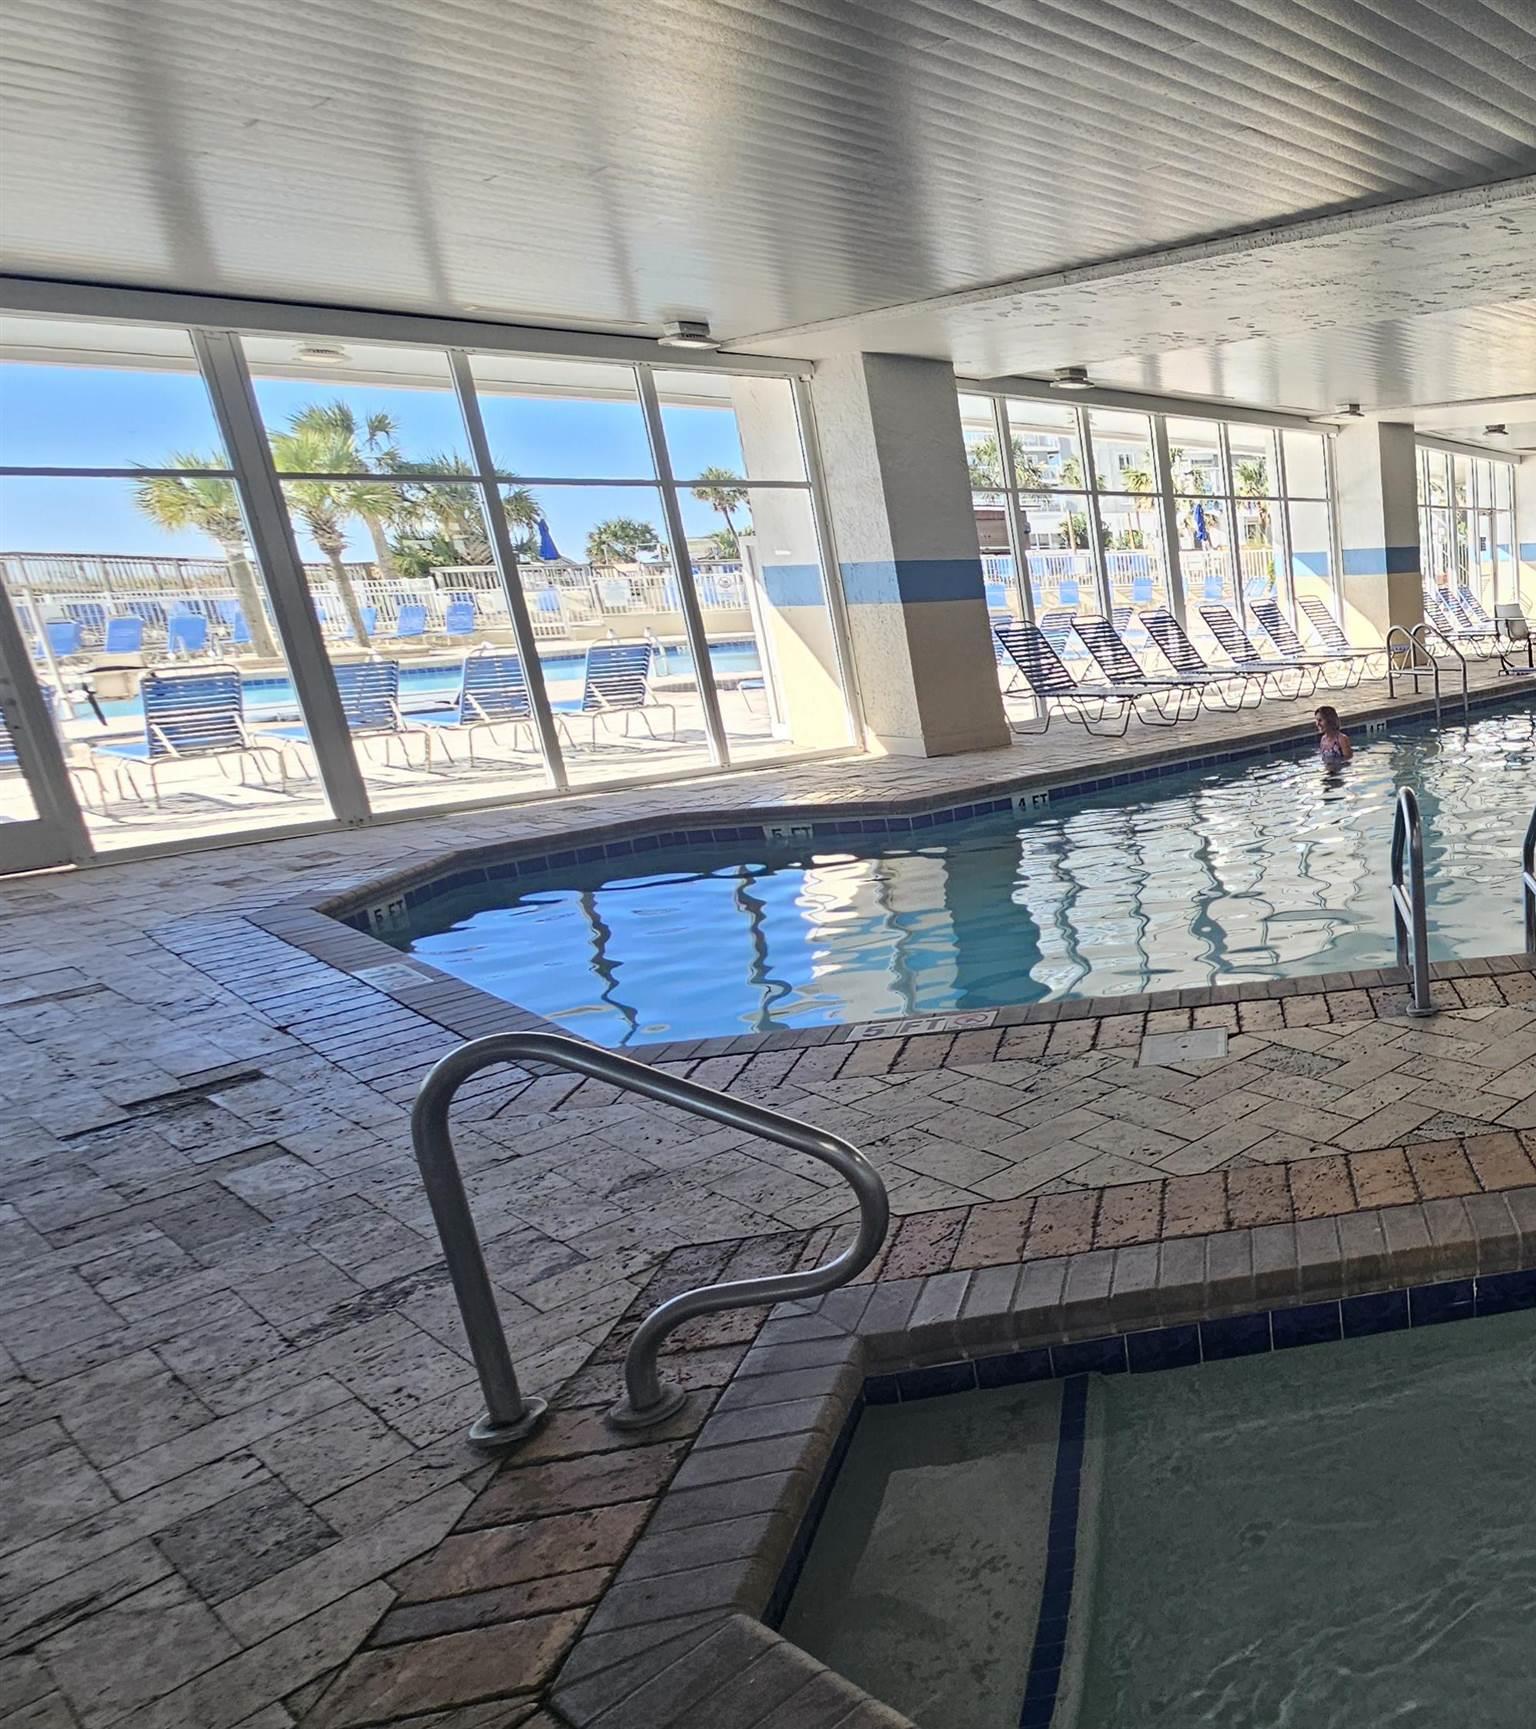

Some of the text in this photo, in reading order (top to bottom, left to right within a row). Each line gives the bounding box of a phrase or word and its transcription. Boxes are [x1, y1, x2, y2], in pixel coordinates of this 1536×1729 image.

[1032, 793, 1047, 808] FT
[862, 1024, 887, 1037] 5
[901, 1018, 946, 1033] FT
